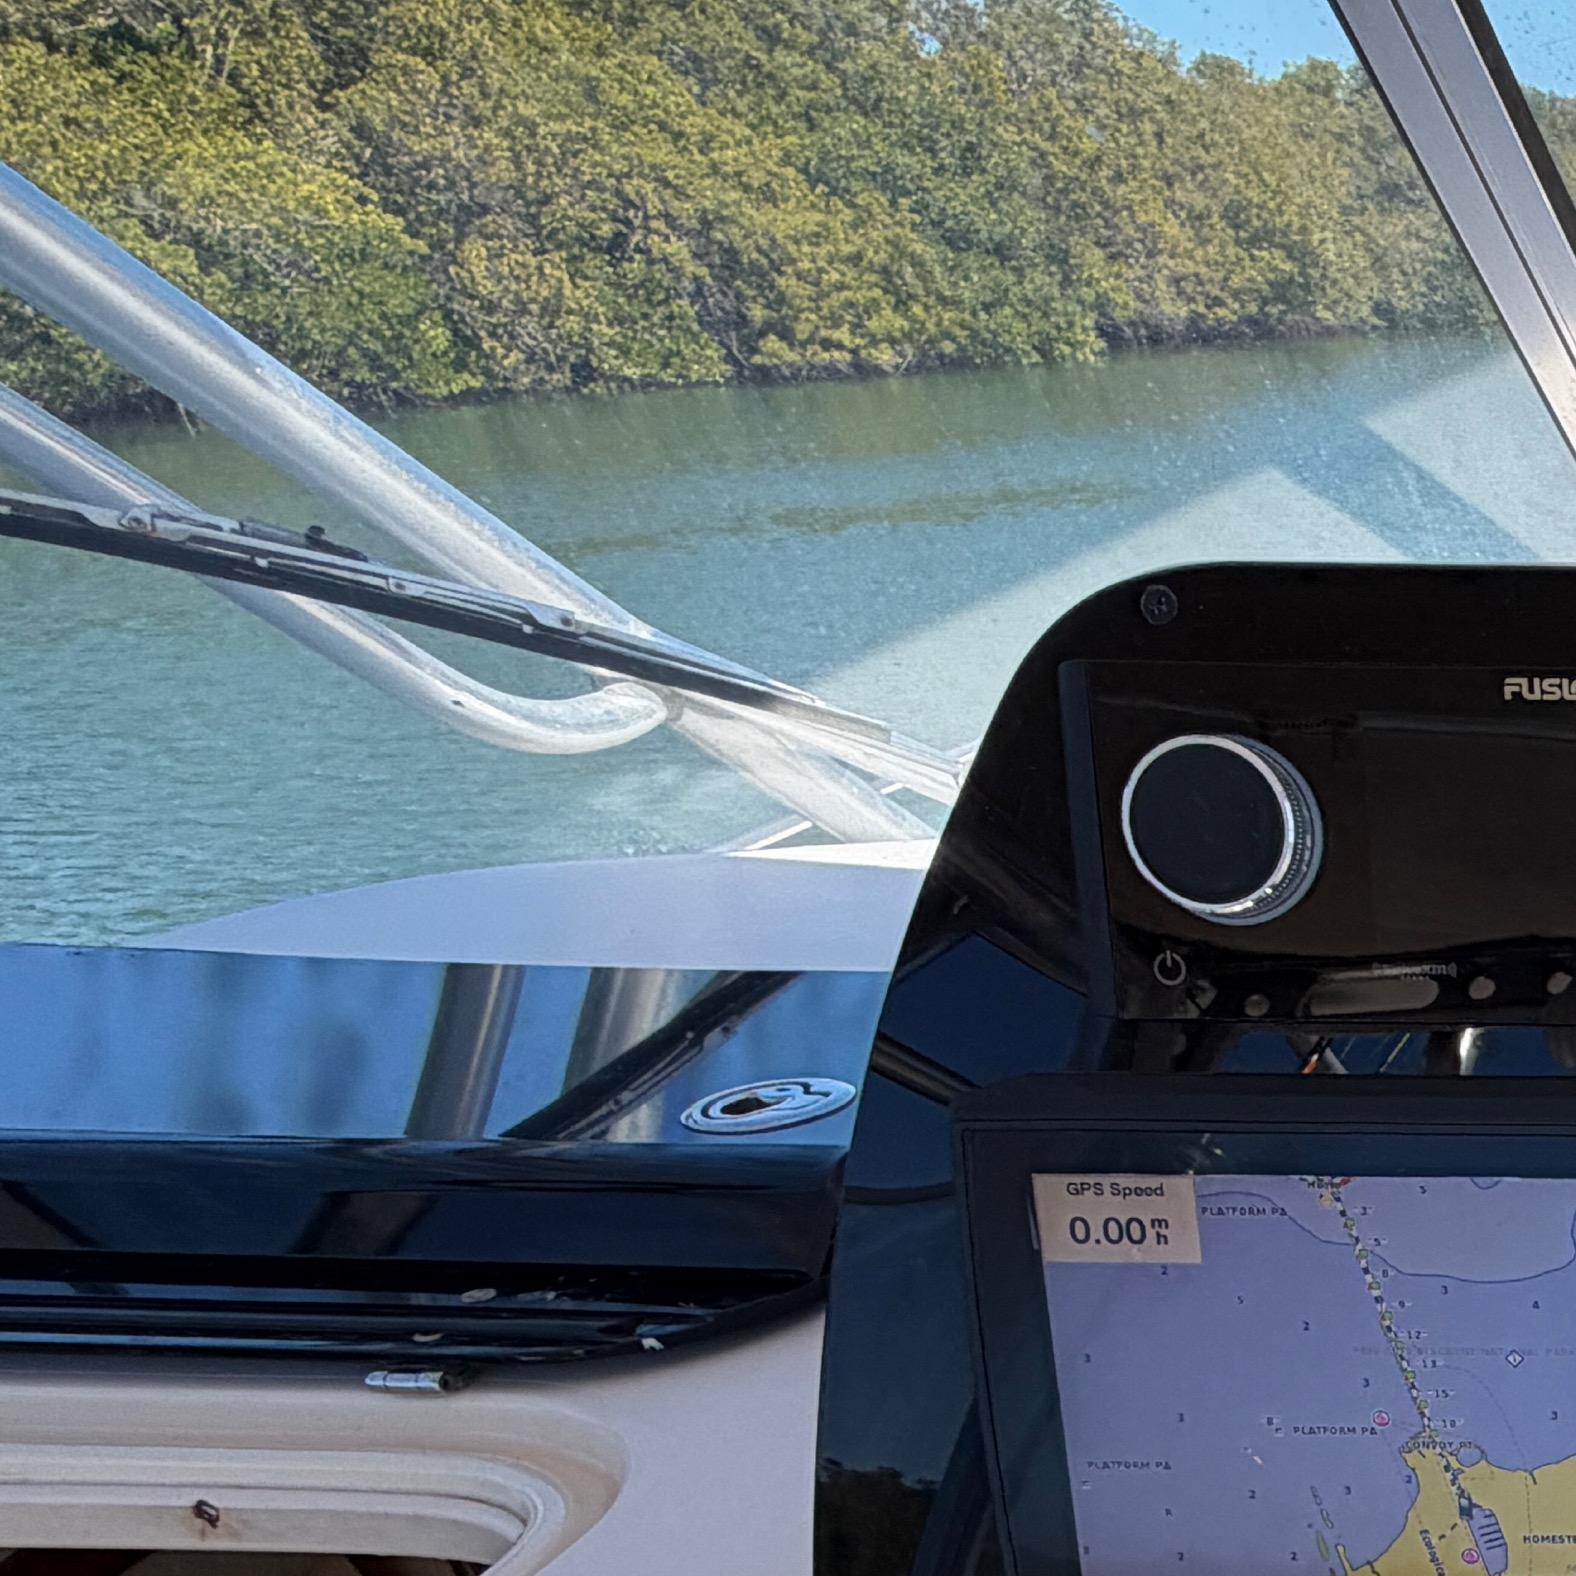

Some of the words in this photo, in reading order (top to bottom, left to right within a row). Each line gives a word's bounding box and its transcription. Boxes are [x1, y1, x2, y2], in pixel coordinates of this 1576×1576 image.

[1066, 1182, 1105, 1197] GPS
[1109, 1182, 1165, 1200] Speed
[1068, 1215, 1148, 1245] 0.00
